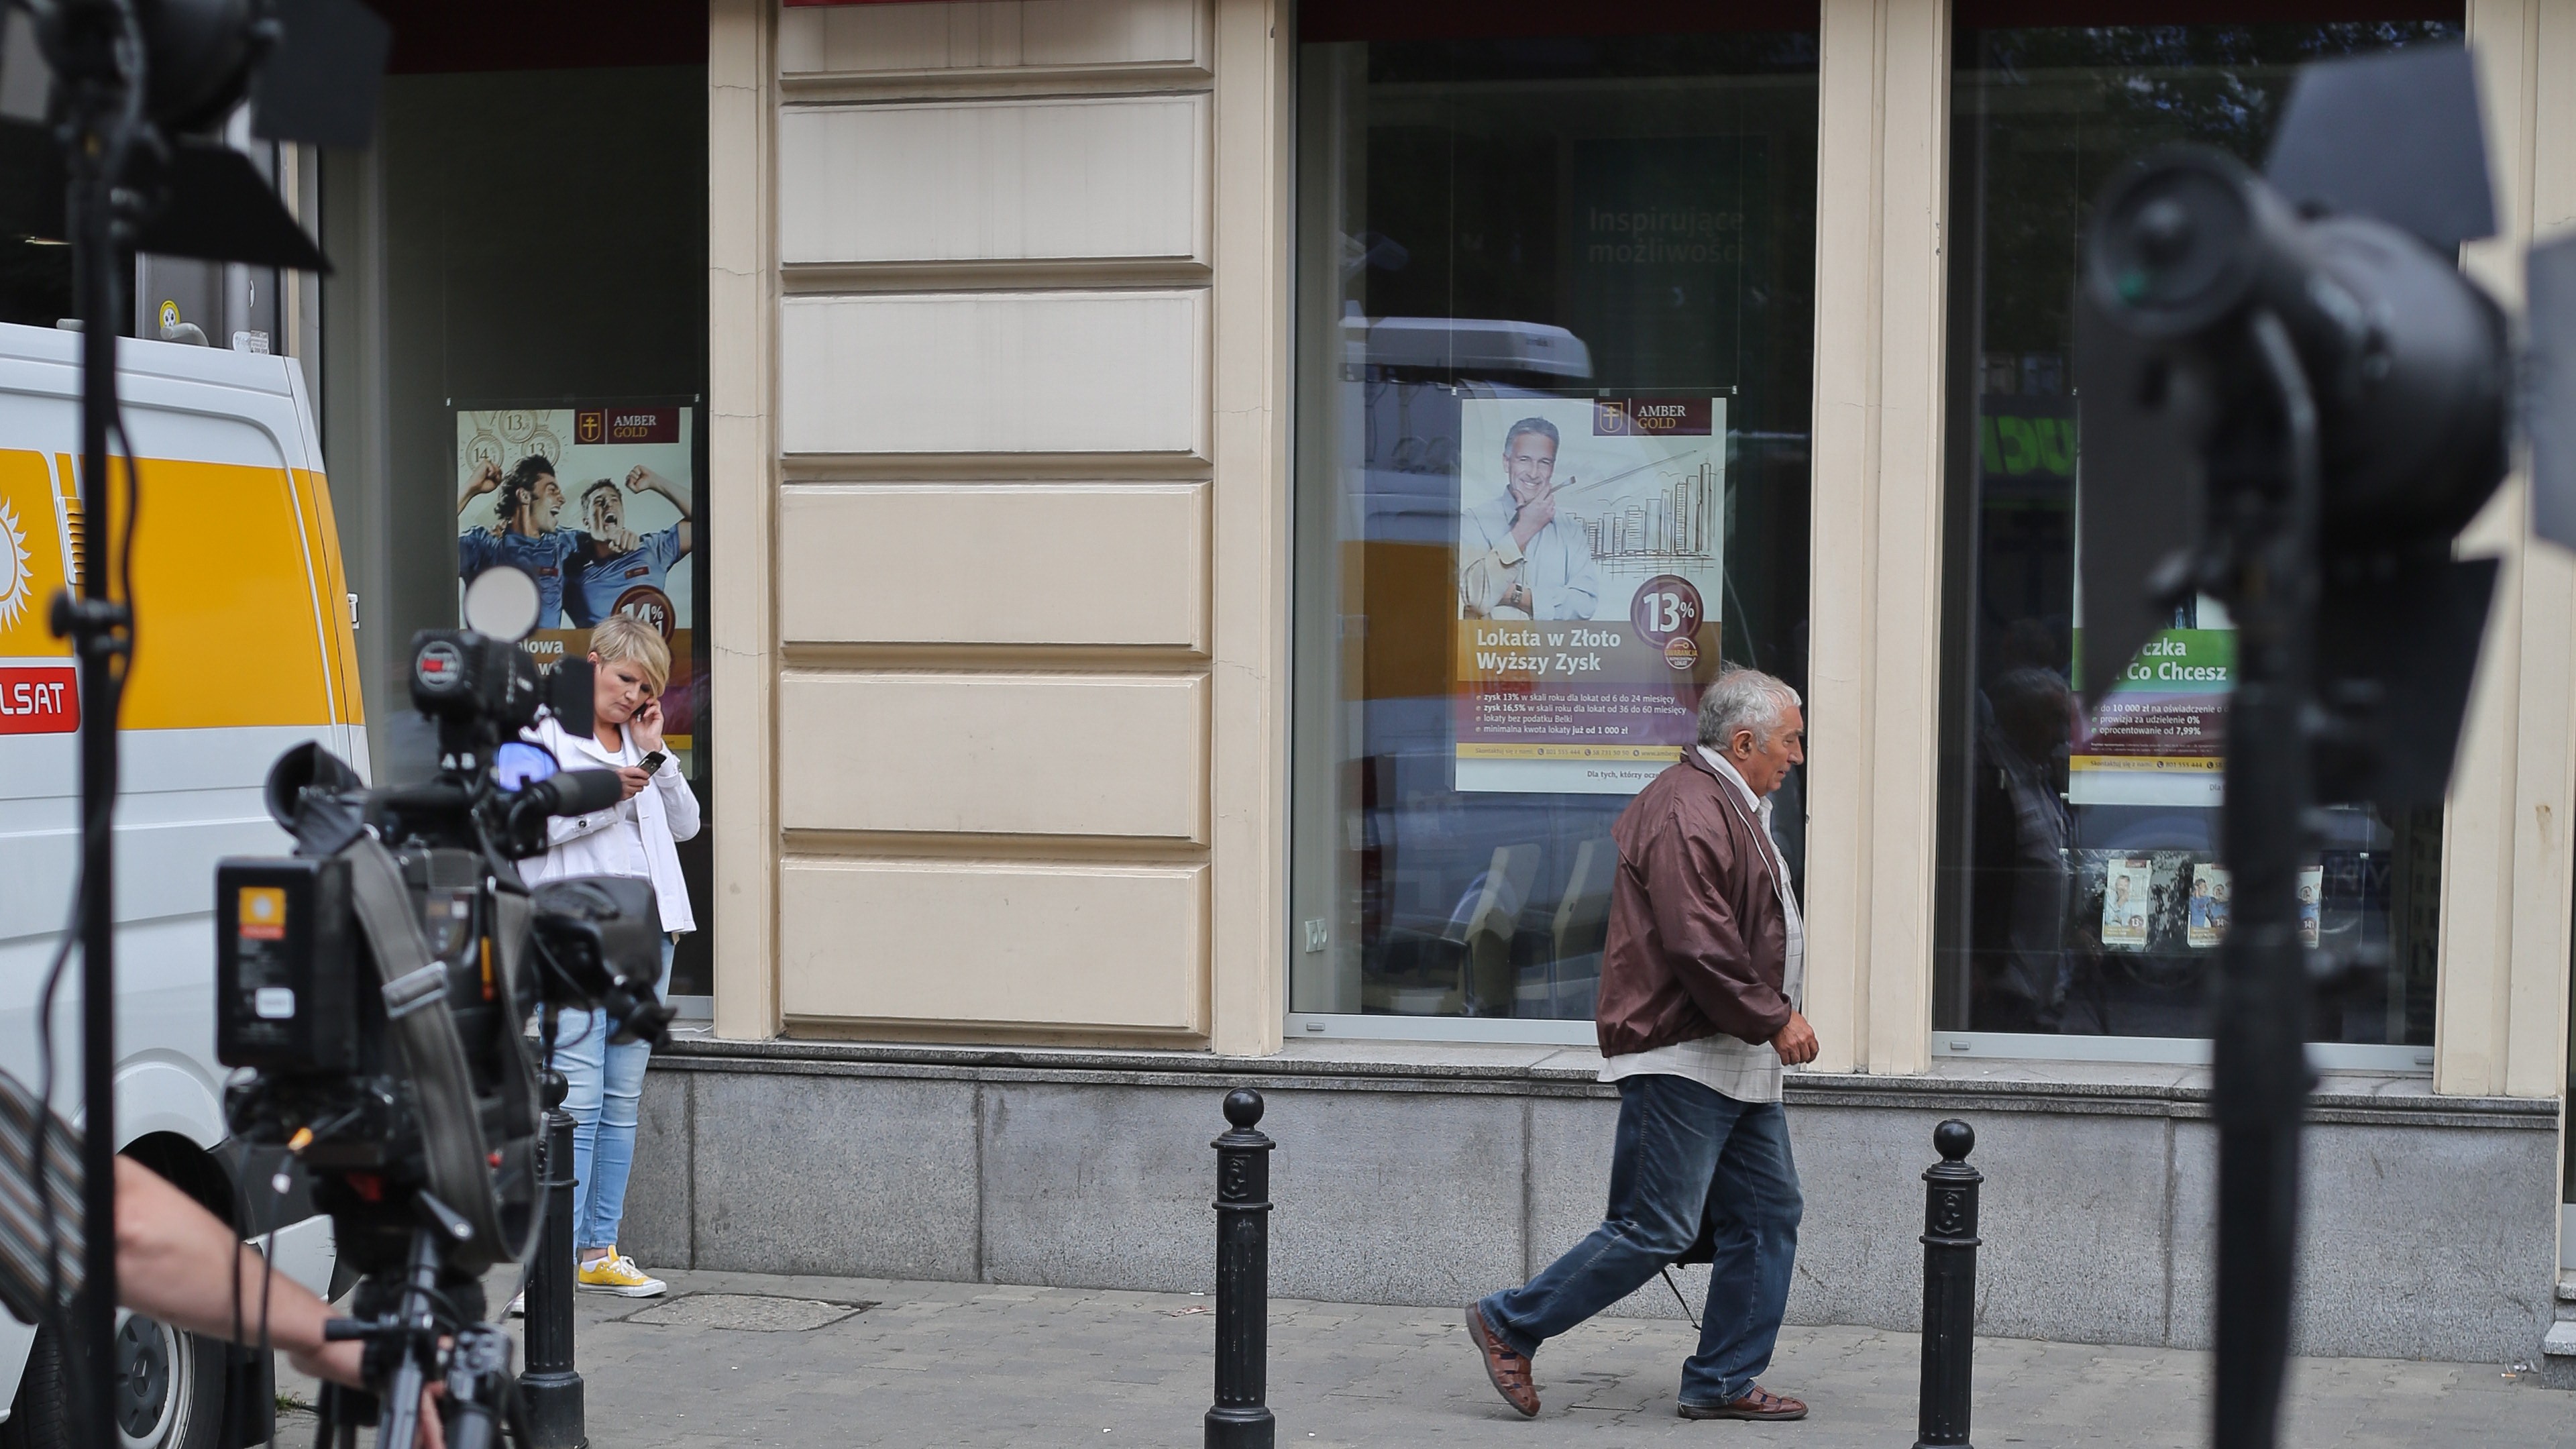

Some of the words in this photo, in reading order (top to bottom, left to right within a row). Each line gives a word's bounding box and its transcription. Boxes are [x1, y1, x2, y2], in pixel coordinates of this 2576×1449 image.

[1638, 405, 1686, 417] AMBER
[614, 415, 657, 426] AMBER
[1638, 417, 1676, 429] GOLD
[614, 427, 648, 437] GOLD
[1643, 592, 1695, 633] 13%
[1477, 629, 1541, 646] Lokata
[1547, 633, 1564, 646] w
[1570, 629, 1621, 647] Złoto
[2132, 637, 2187, 659] czka
[1477, 651, 1549, 675] Wyższy
[1556, 653, 1601, 675] Zysk
[2127, 662, 2152, 680] Co
[2157, 661, 2227, 680] Chcesz
[1484, 693, 1501, 702] zysk
[1503, 693, 1519, 701] 13%
[1529, 693, 1546, 701] skali
[1567, 694, 1578, 702] dla
[1580, 694, 1599, 702] lokat
[1619, 694, 1629, 702] do
[1643, 694, 1675, 704] miesięcy
[1483, 703, 1501, 712] zysk
[1503, 704, 1525, 712] 16,5%
[1654, 706, 1686, 715] miesięcy
[2163, 704, 2215, 713] oświadczenie
[1484, 714, 1506, 723] lokaty
[1523, 715, 1552, 724] podatku
[2100, 715, 2133, 724] prowizja
[2146, 715, 2185, 724] udzielenie
[2187, 716, 2200, 724] 0%
[1548, 726, 1570, 735] lokaty
[1572, 726, 1583, 735] już
[2100, 727, 2161, 735] oprocentowanie
[2163, 727, 2174, 735] od
[2176, 727, 2201, 736] 7,99%
[1601, 771, 1618, 779] tych,
[1620, 771, 1642, 779] którzy
